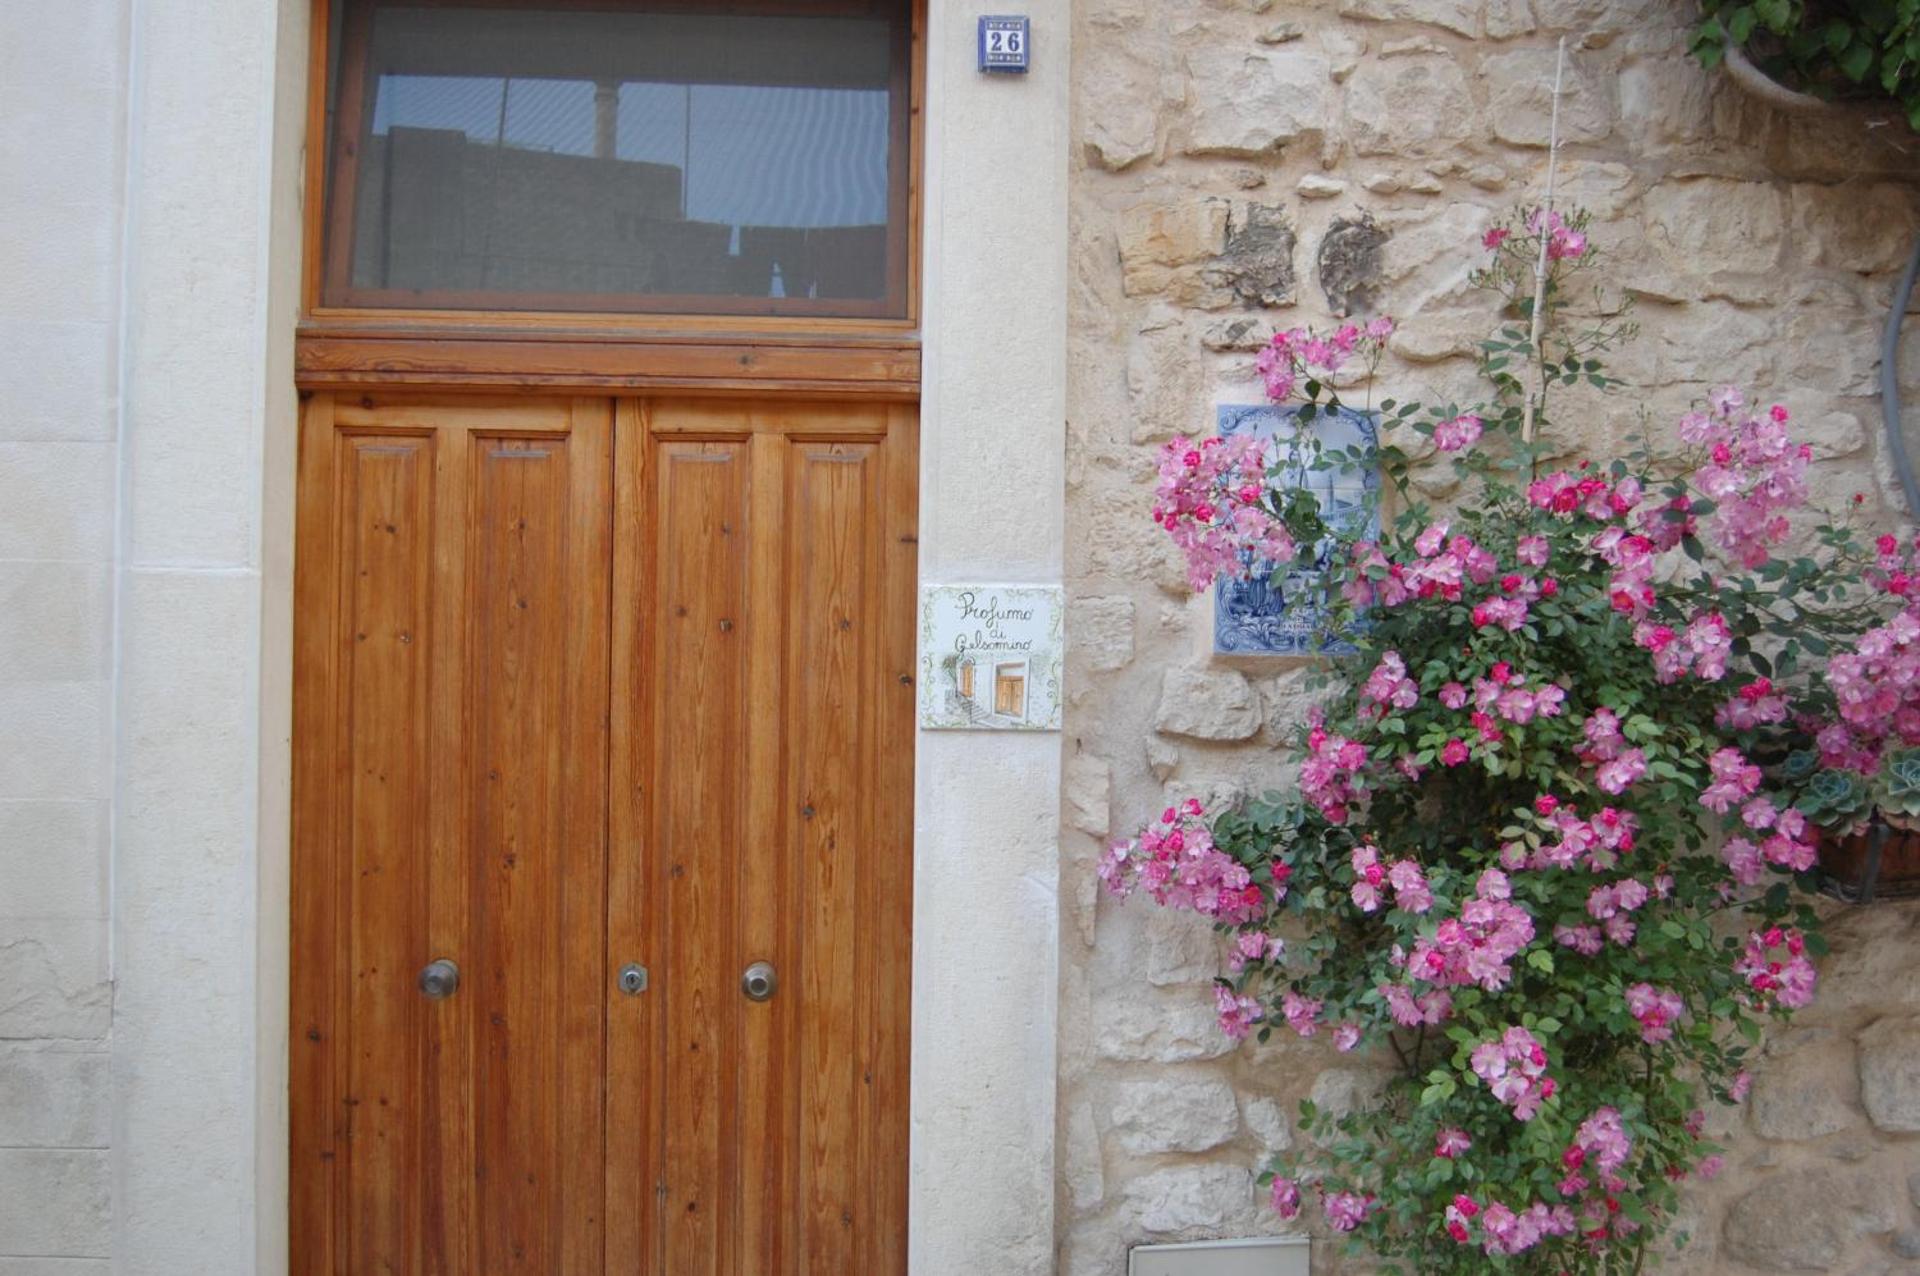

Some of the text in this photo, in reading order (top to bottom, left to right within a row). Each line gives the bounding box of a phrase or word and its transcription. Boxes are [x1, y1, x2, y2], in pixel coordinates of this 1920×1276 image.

[991, 31, 1020, 52] 26
[955, 592, 1034, 628] Profumo
[955, 630, 1033, 654] Gelsomino
